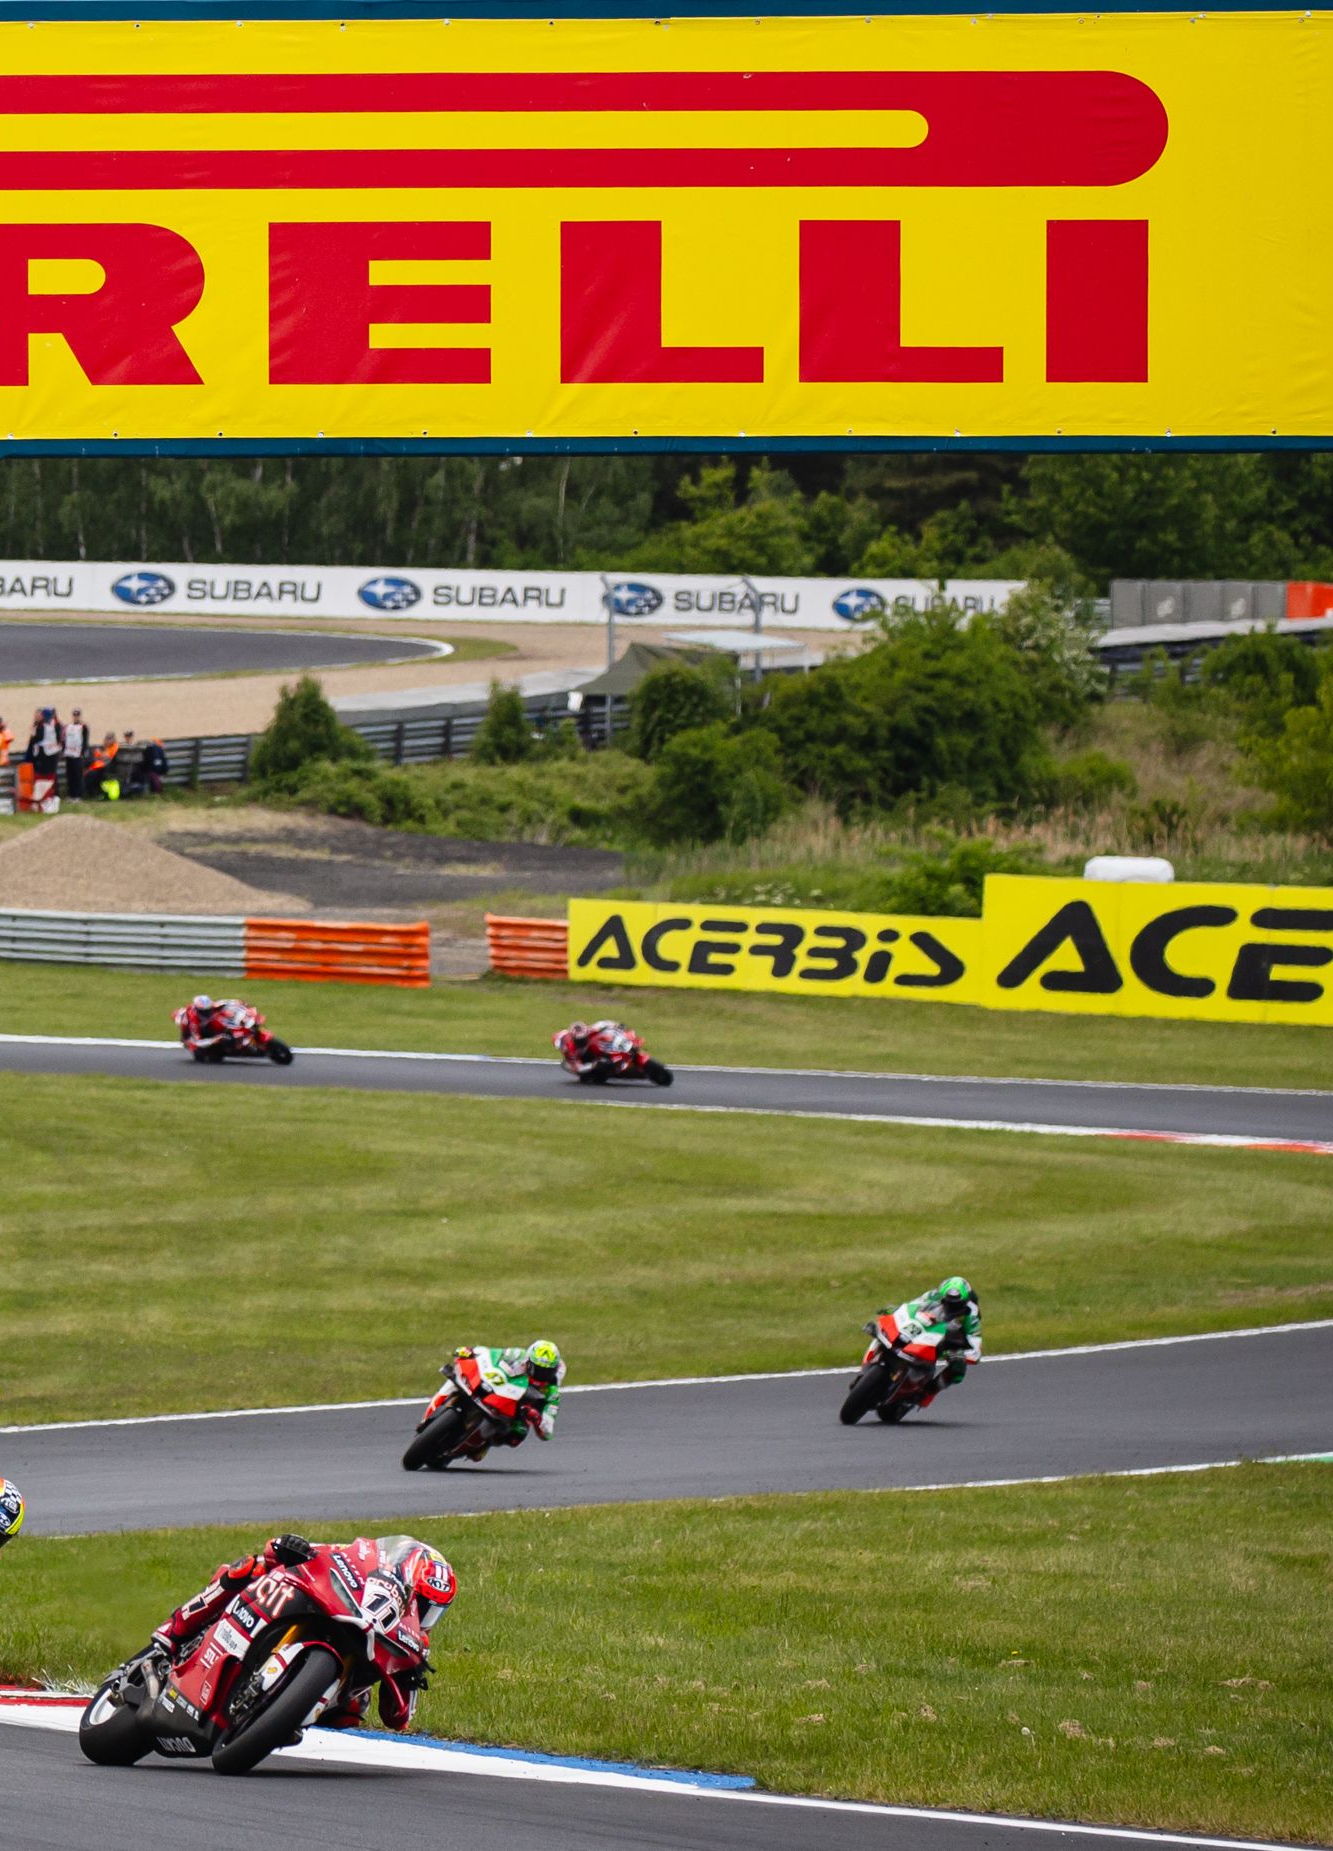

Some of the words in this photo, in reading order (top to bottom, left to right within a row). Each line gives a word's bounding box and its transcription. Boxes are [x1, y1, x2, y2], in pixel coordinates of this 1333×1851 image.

[188, 581, 322, 603] SUBARU
[434, 586, 566, 608] SUBARU
[675, 589, 800, 616] SUBARU
[578, 915, 966, 986] ACERBIS
[332, 1554, 358, 1589] Lenovo
[364, 1592, 400, 1631] 11
